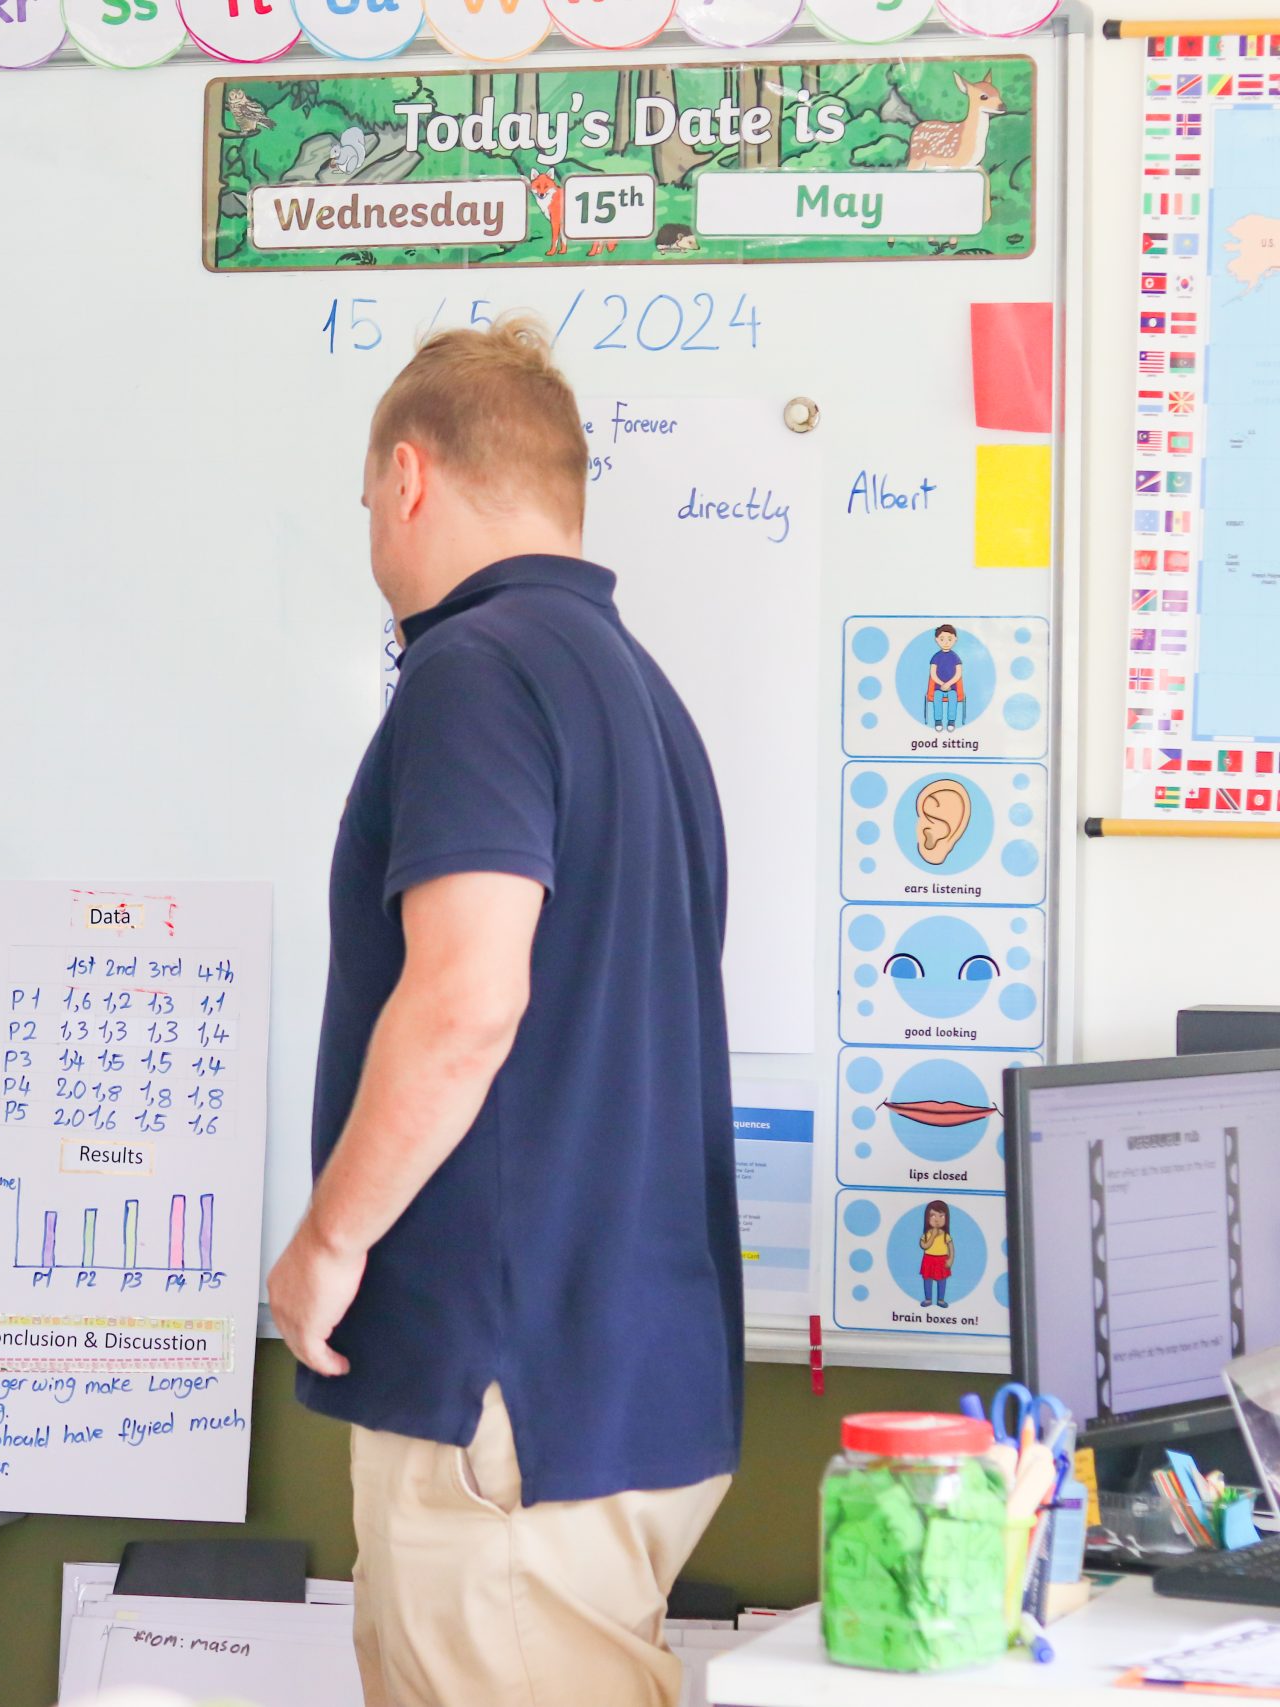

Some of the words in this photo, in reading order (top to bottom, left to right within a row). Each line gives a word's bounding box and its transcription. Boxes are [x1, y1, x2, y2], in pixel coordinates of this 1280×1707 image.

[393, 92, 611, 166] Today's
[634, 96, 773, 147] Date
[794, 89, 846, 145] is
[273, 190, 505, 237] Wednesday
[574, 185, 645, 225] 15th
[796, 184, 884, 229] May
[322, 297, 382, 354] 15
[593, 292, 762, 351] 2024
[611, 401, 678, 444] Forever
[847, 470, 937, 514] Albert
[677, 487, 790, 543] directly
[911, 738, 938, 751] good
[942, 738, 979, 751] sitting
[904, 885, 929, 893] ears
[932, 883, 982, 897] listening
[90, 908, 131, 925] Data
[67, 956, 96, 978] 1st
[106, 956, 137, 978] 2nd
[149, 957, 182, 978] 3rd
[198, 960, 234, 983] 4th
[904, 1027, 932, 1038] good
[936, 1027, 977, 1041] looking
[79, 1145, 144, 1166] Results
[909, 1168, 929, 1182] lips
[932, 1170, 968, 1181] closed
[892, 1311, 922, 1323] brain
[926, 1313, 957, 1325] boxes
[961, 1316, 979, 1326] on!
[84, 1330, 98, 1349] &
[104, 1331, 208, 1352] Discusstion
[32, 1377, 76, 1404] wing
[85, 1376, 133, 1394] make
[63, 1424, 104, 1444] have
[189, 1409, 246, 1436] much
